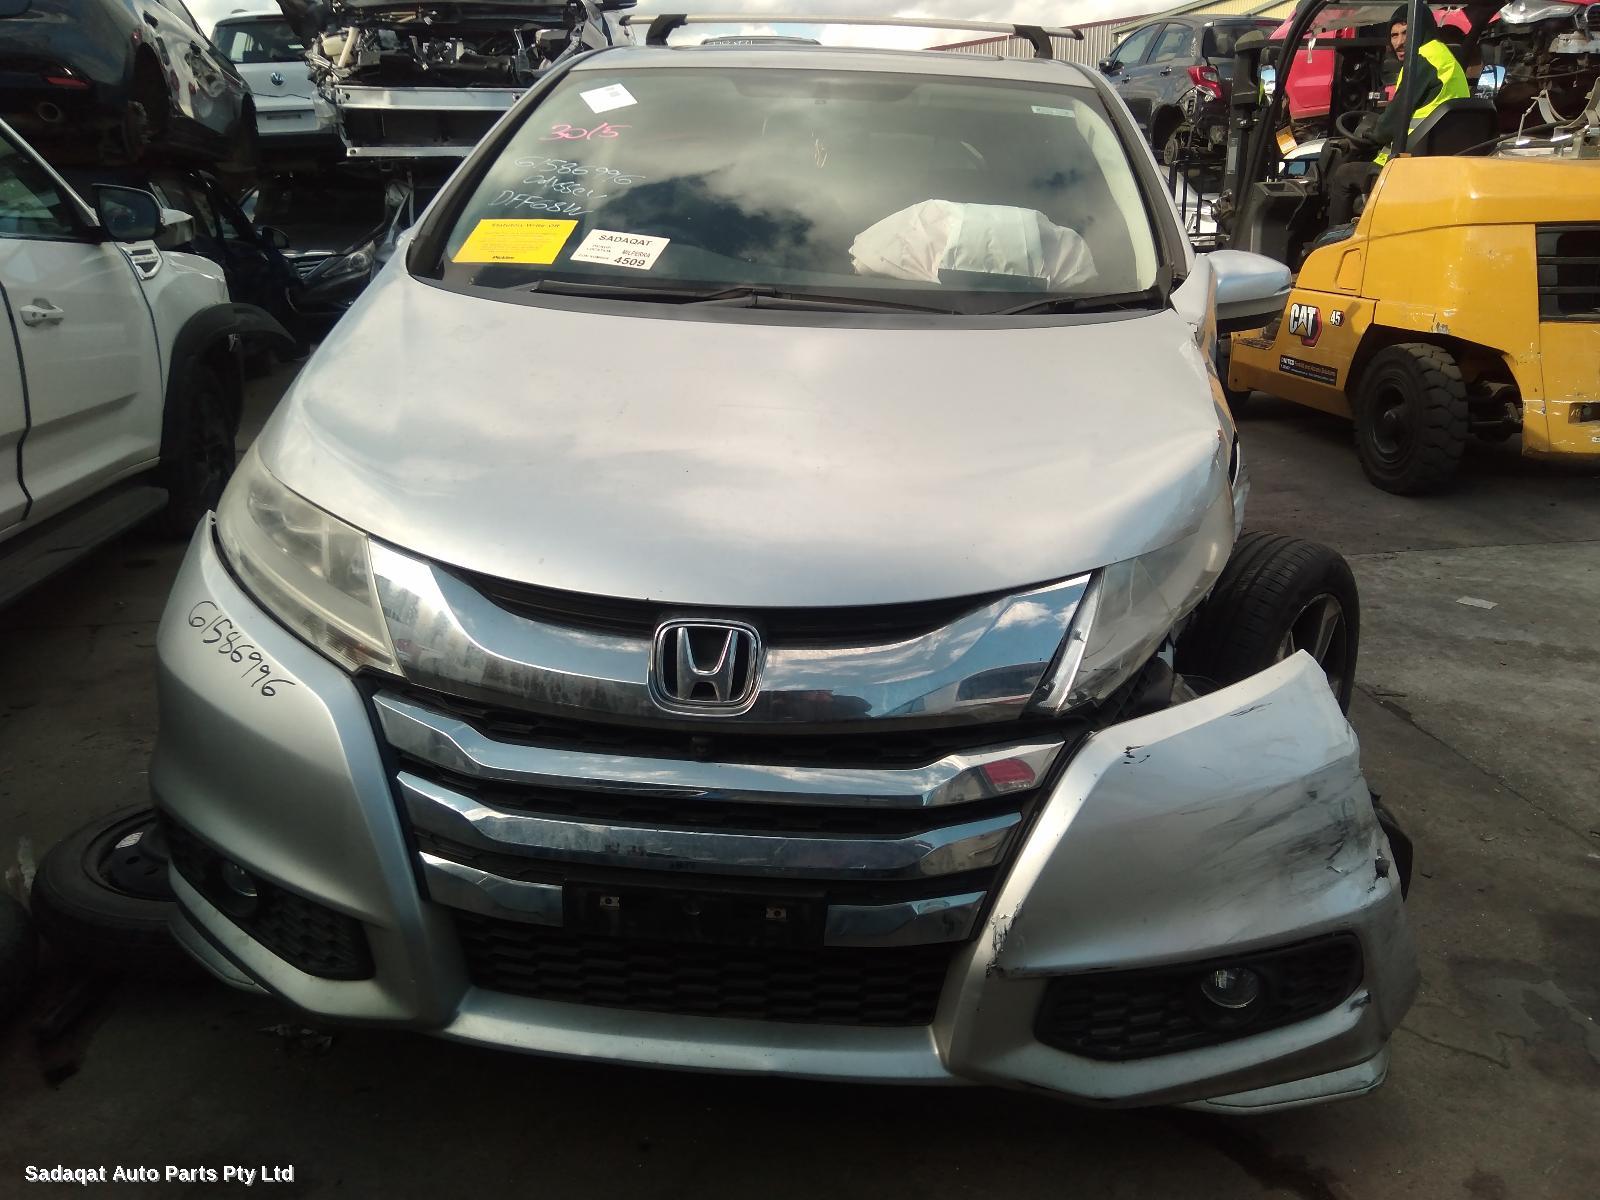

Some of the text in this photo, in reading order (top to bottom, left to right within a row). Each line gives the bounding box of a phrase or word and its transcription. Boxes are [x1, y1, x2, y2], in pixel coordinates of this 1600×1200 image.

[538, 122, 632, 140] 30/5
[598, 234, 653, 247] SADAQAT
[613, 256, 646, 267] 4509
[1289, 303, 1317, 337] CAT
[1330, 310, 1341, 326] 45
